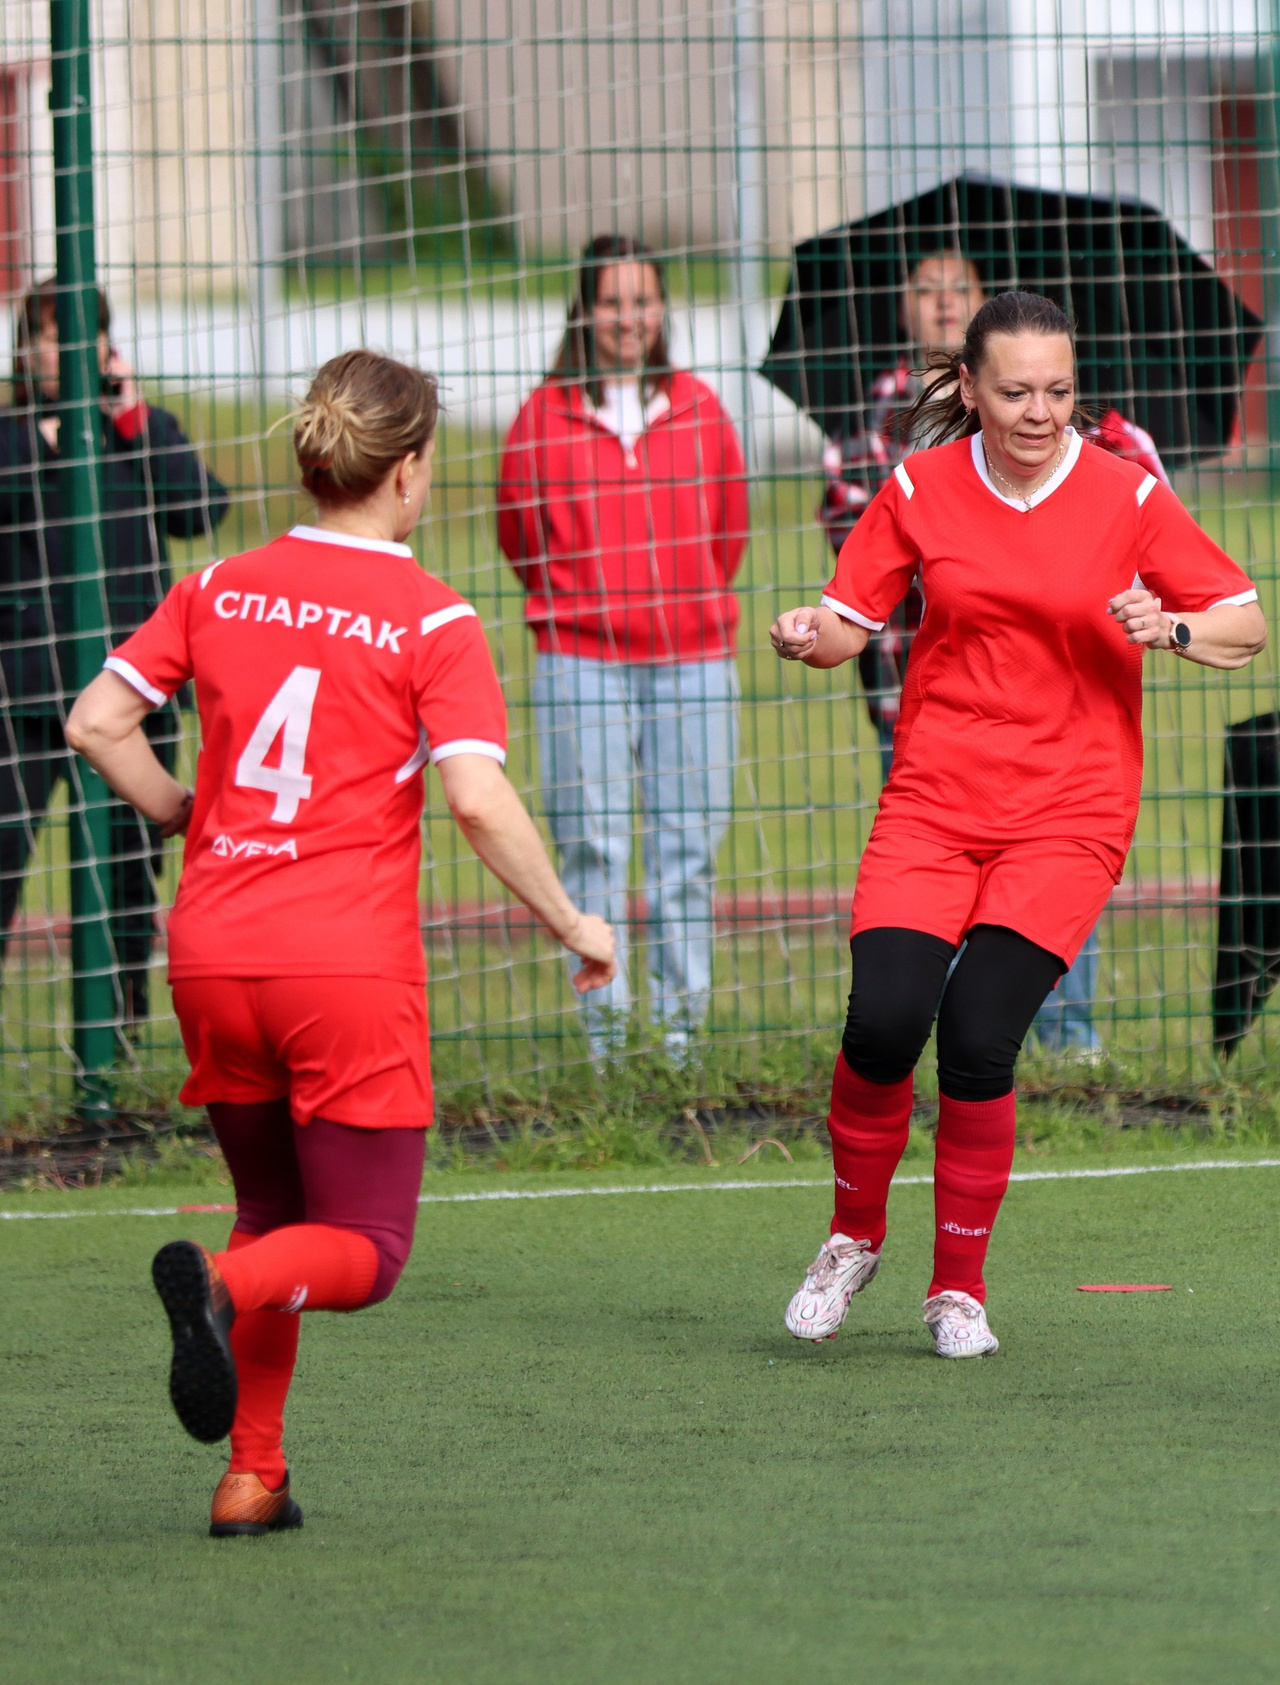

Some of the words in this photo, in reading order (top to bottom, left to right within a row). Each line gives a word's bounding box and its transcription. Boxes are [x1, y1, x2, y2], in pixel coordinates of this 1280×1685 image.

[213, 590, 409, 654] СПАРТАК
[234, 664, 322, 825] 4
[940, 1221, 991, 1237] JÖGEL
